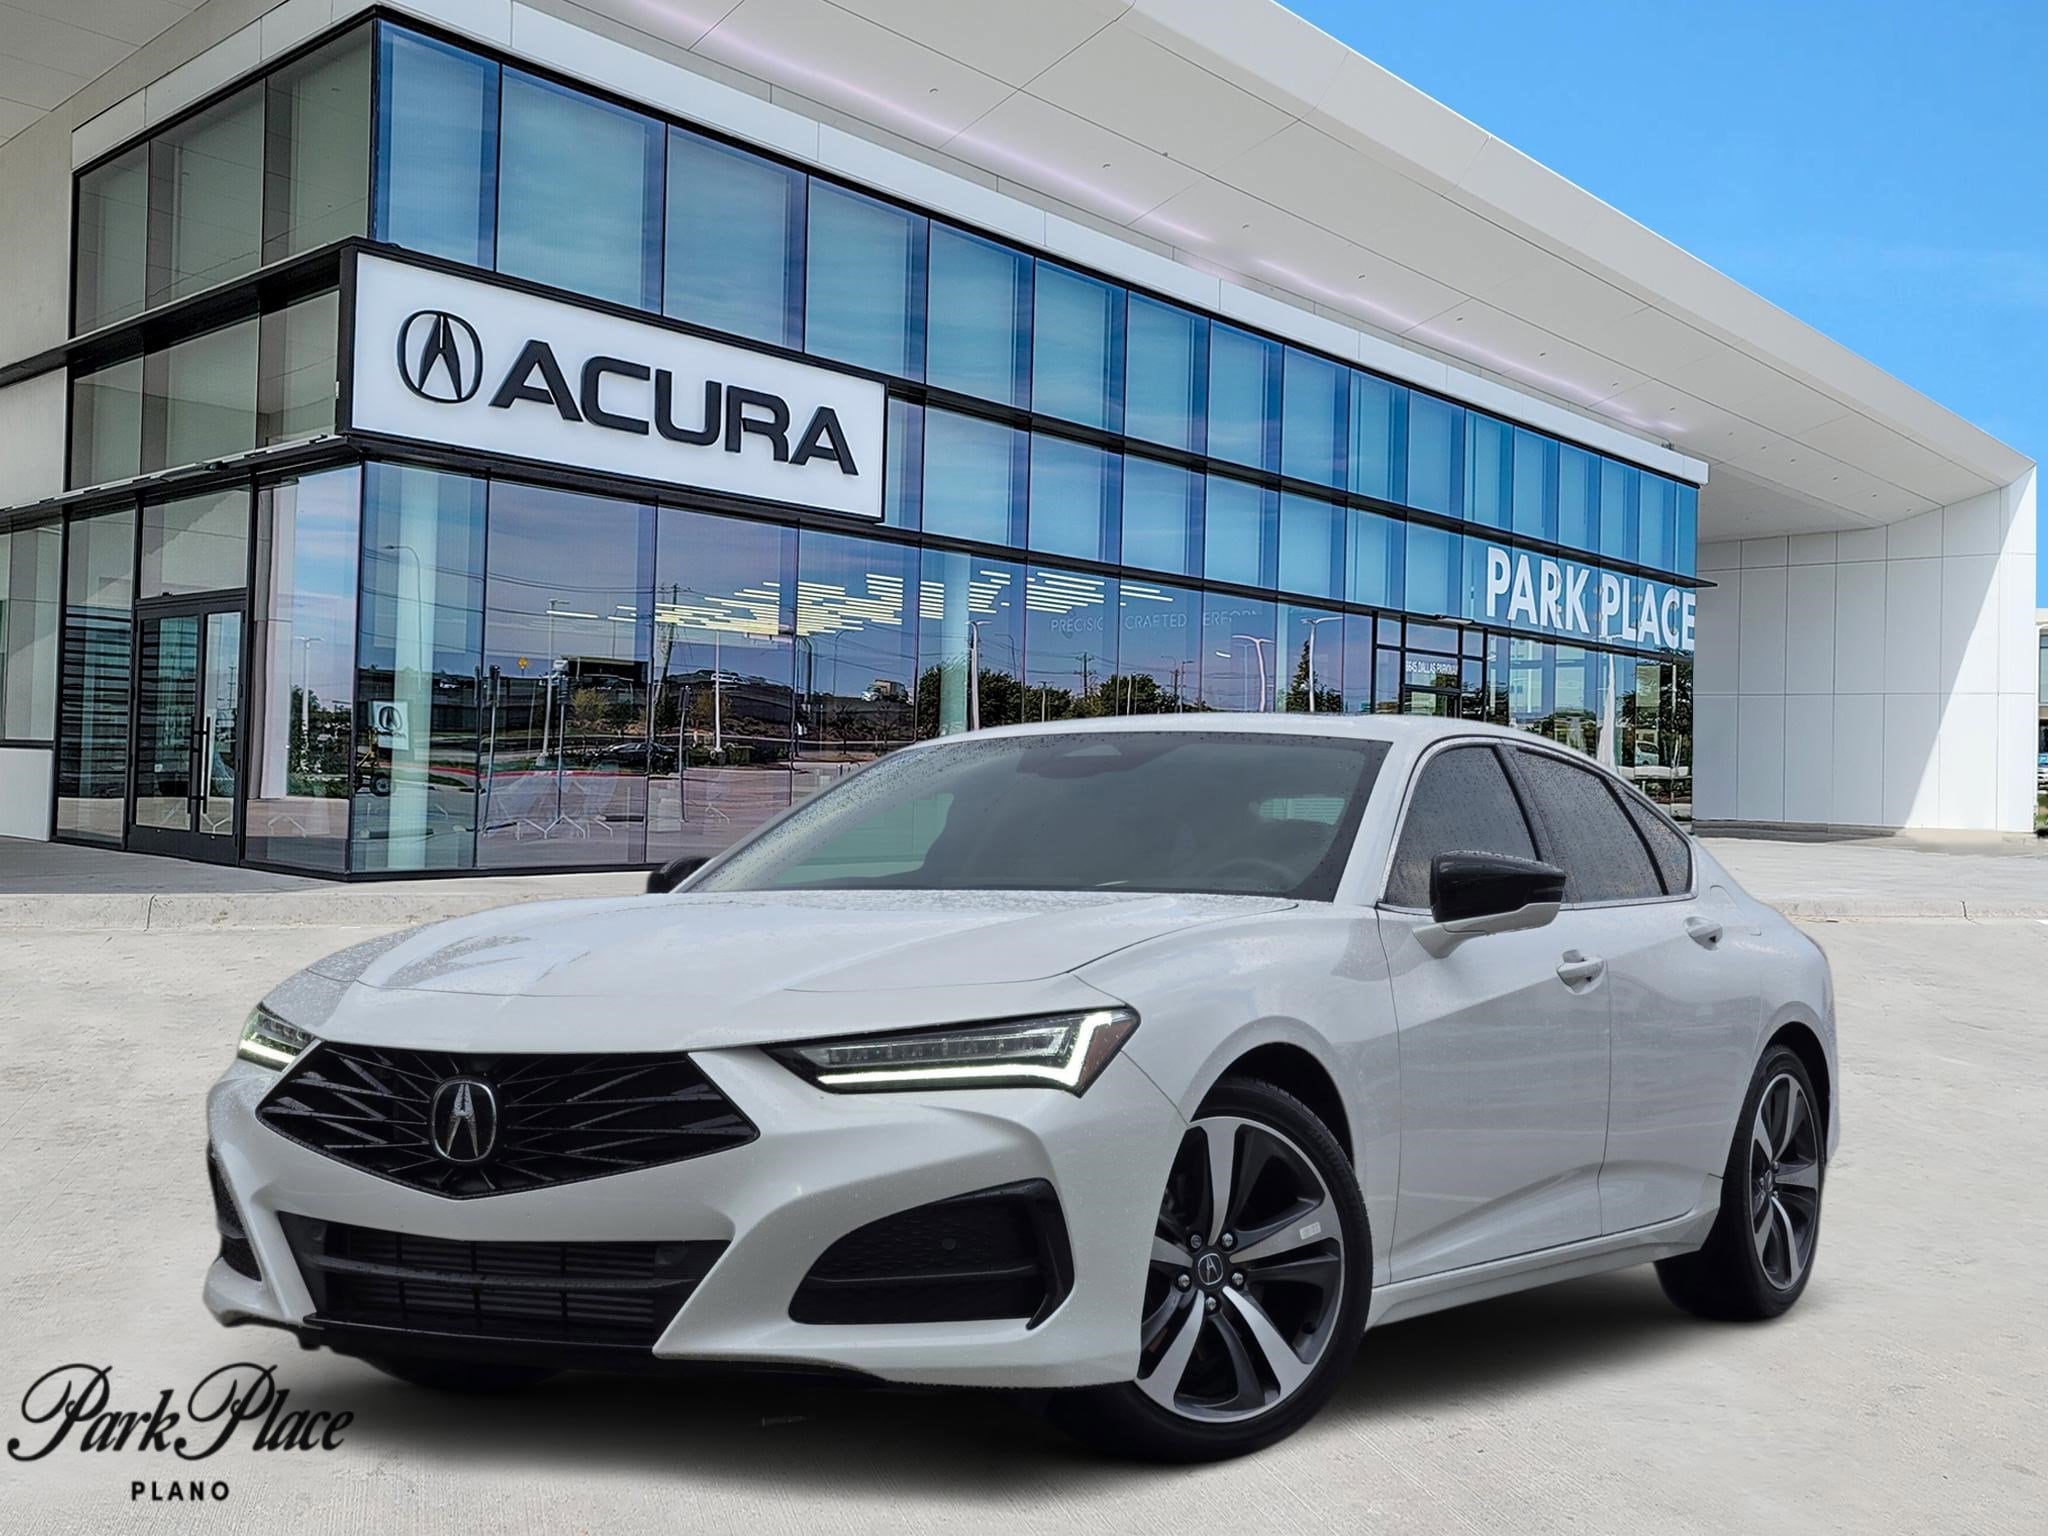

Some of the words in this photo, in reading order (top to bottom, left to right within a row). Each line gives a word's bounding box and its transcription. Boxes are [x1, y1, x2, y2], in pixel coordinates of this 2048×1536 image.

[489, 338, 860, 475] ACURA
[1124, 612, 1188, 630] CRAFTED
[1486, 546, 1590, 634] PARK
[1600, 572, 1697, 651] PLACE
